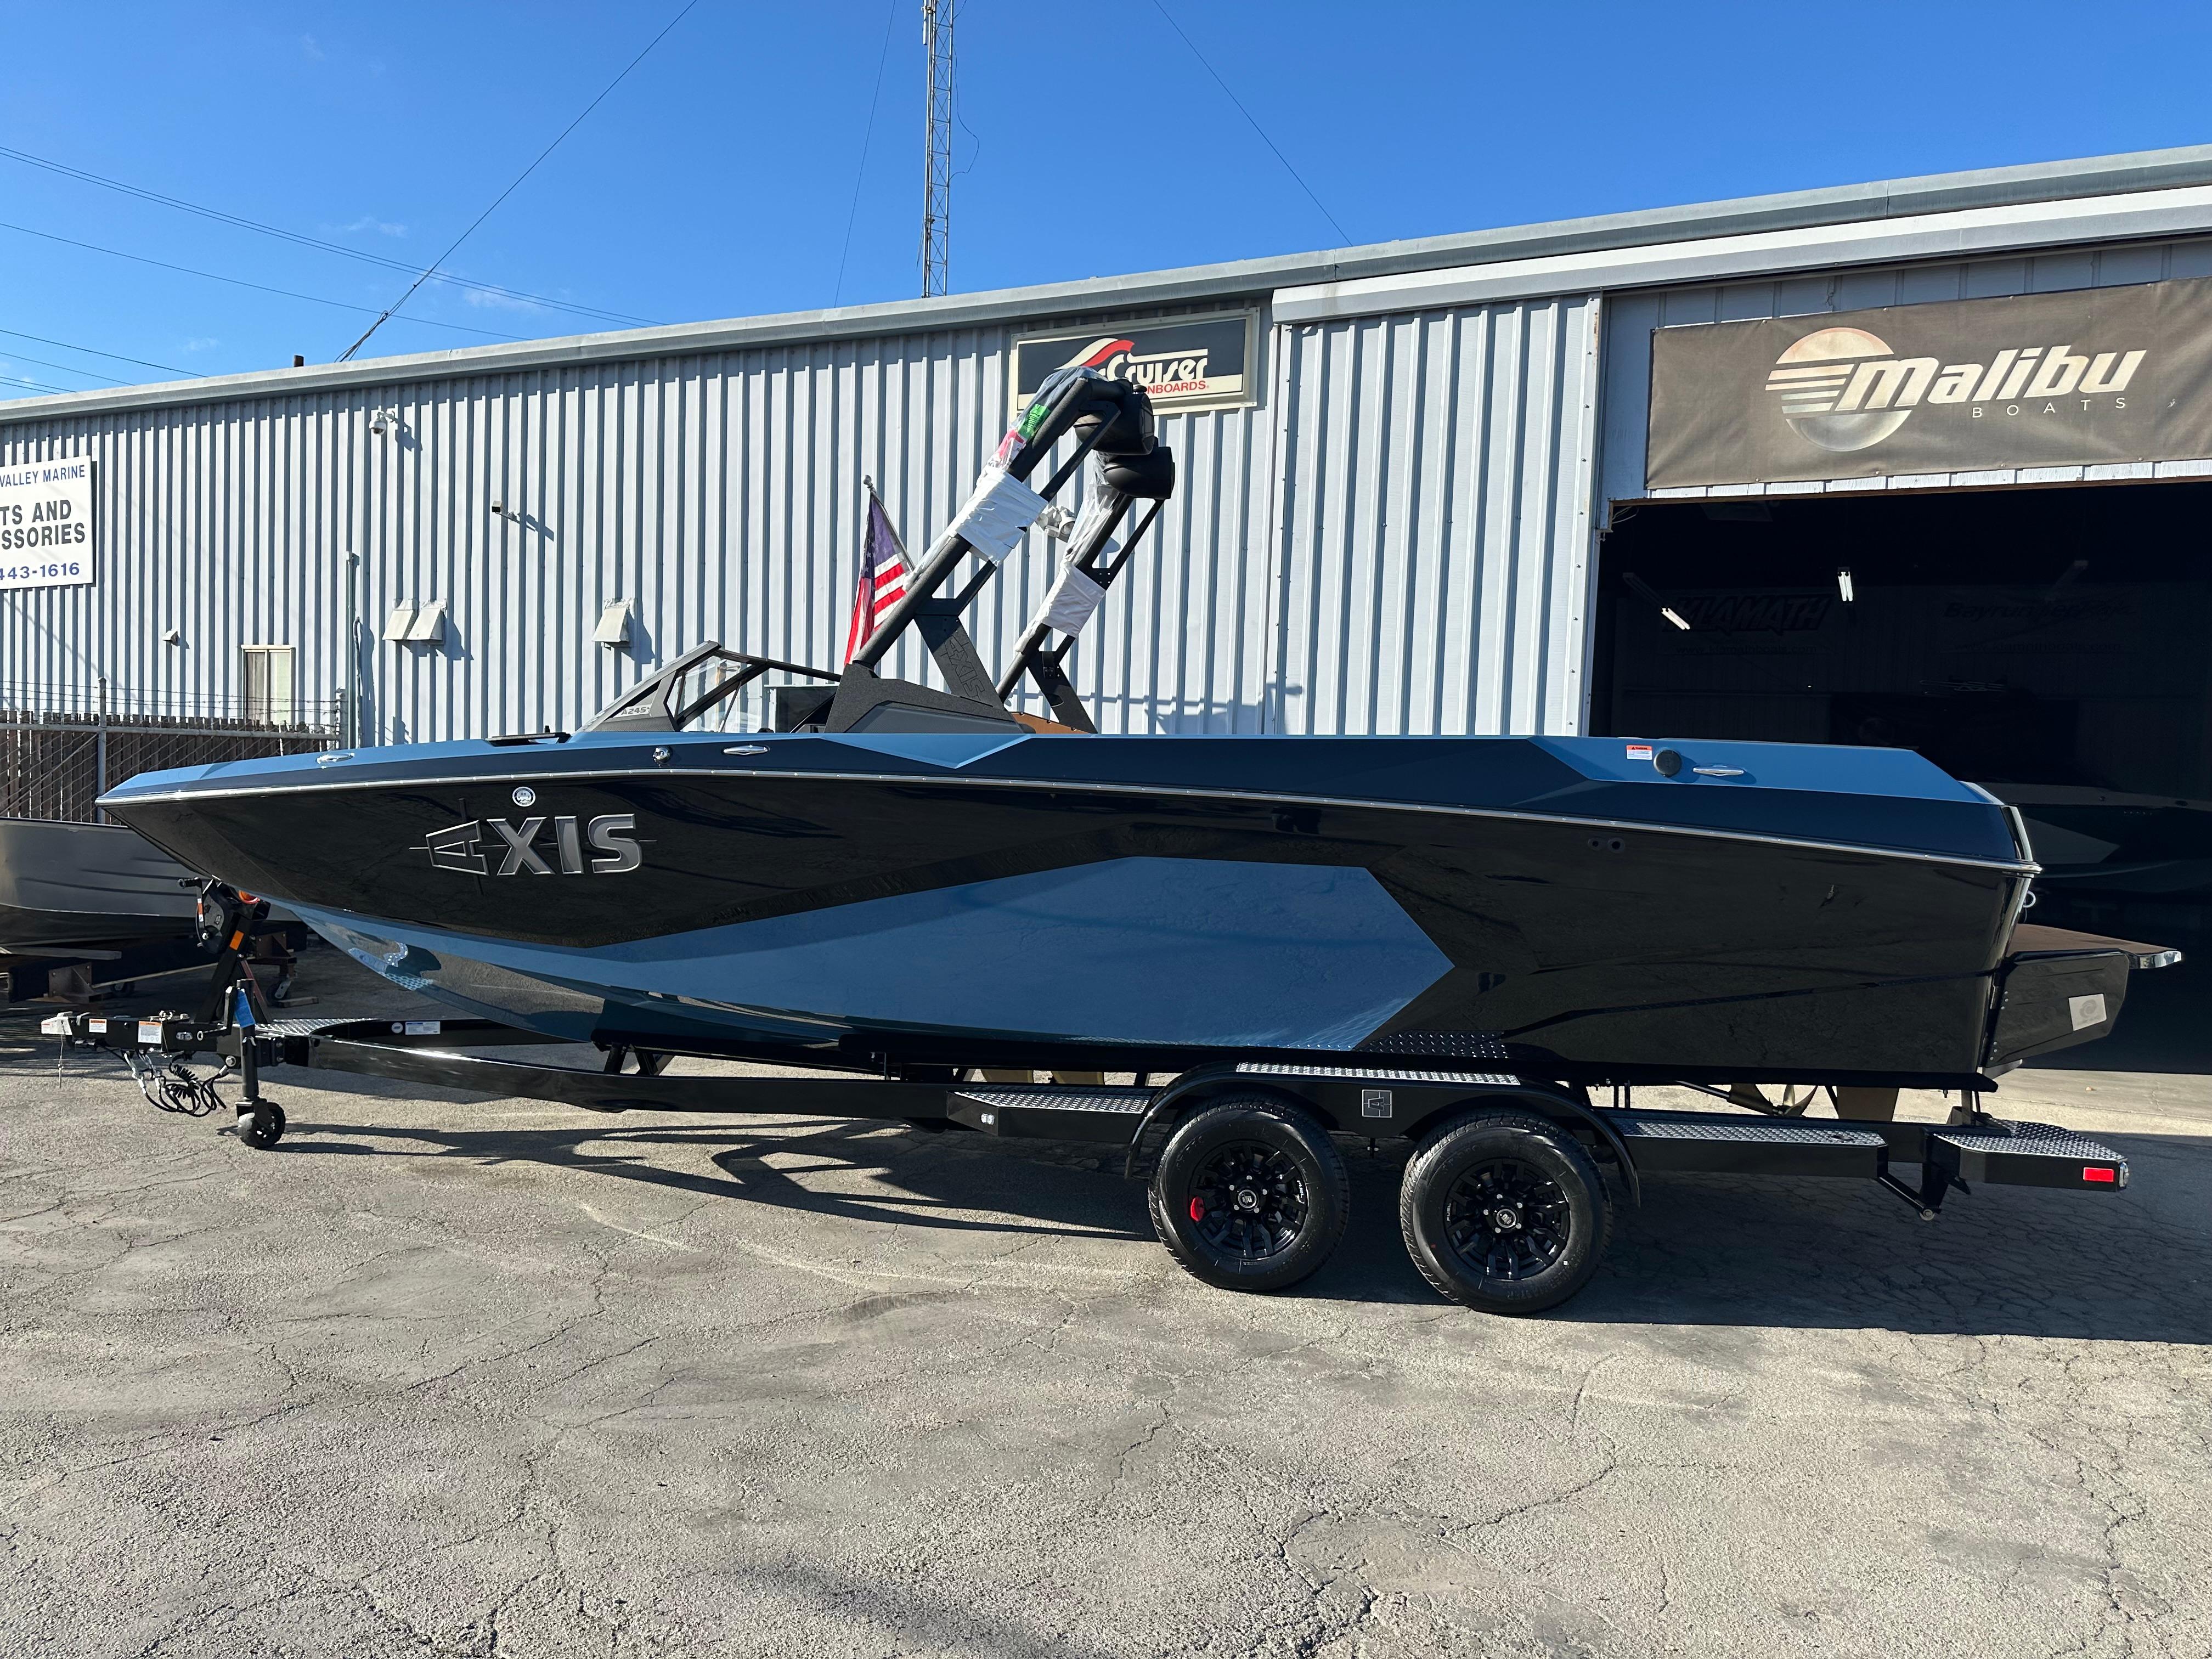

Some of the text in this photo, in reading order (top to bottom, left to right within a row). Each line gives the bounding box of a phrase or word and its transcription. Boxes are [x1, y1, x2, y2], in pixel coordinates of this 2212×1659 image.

[1147, 380, 1206, 394] NBOARDS
[1972, 397, 2125, 418] BOATS
[0, 465, 85, 487] VALLEY MARINE
[32, 499, 71, 522] AND
[1, 522, 85, 550] SSORIES
[944, 636, 985, 701] AXIS
[425, 814, 642, 876] AXIS
